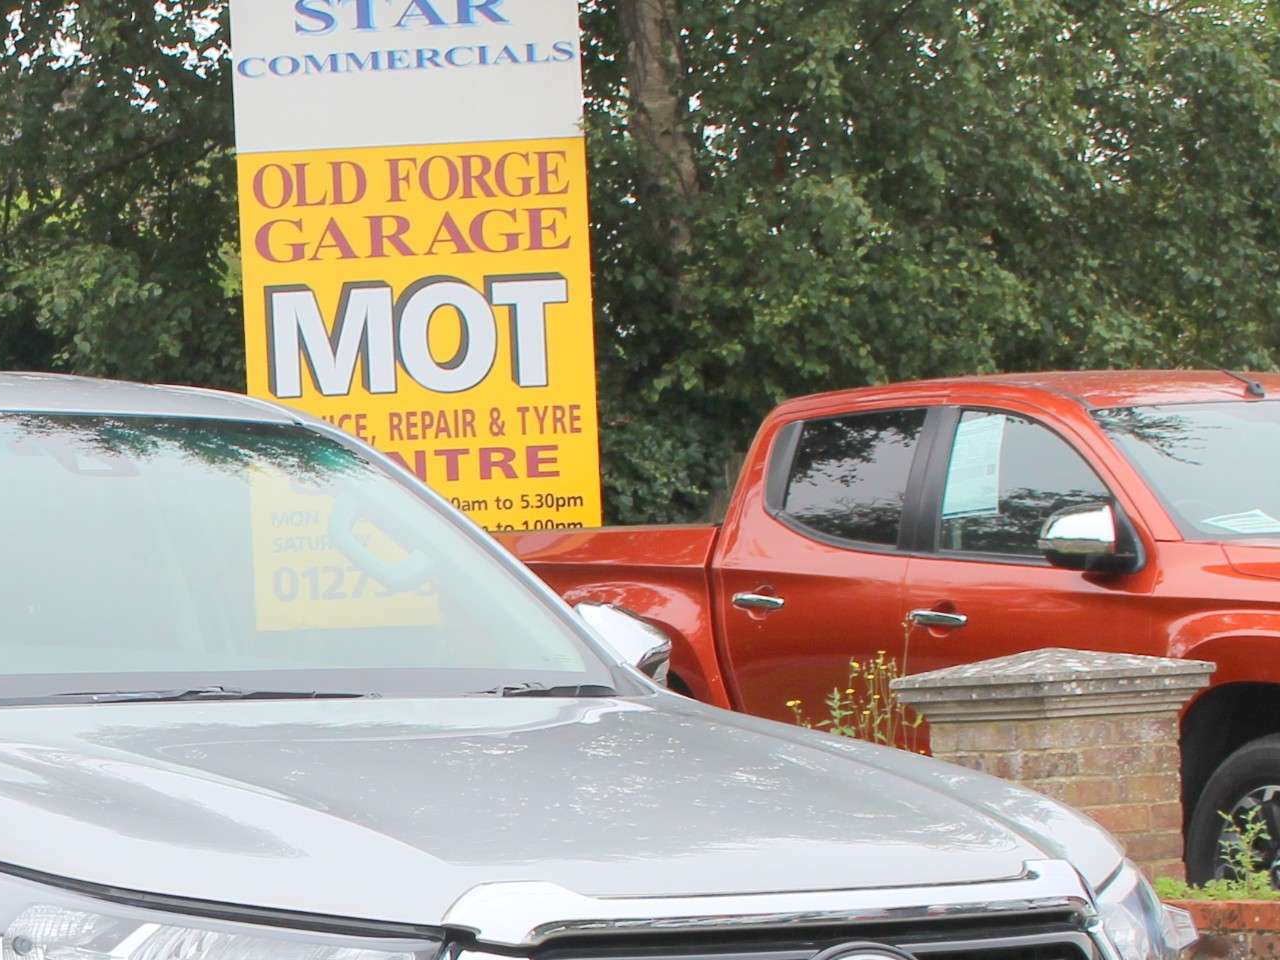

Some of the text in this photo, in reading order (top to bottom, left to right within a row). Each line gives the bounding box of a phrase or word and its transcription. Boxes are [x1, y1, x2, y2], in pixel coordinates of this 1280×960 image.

[294, 0, 512, 34] STAR
[237, 41, 576, 79] COMMERCIALS
[252, 150, 571, 209] OLD FORGE
[254, 207, 572, 264] GARAGE
[264, 272, 569, 398] MOT
[321, 404, 582, 447] CE, REPAIR & TYRE
[384, 444, 561, 483] NTRE
[447, 493, 584, 512] 0am to 5.30pm
